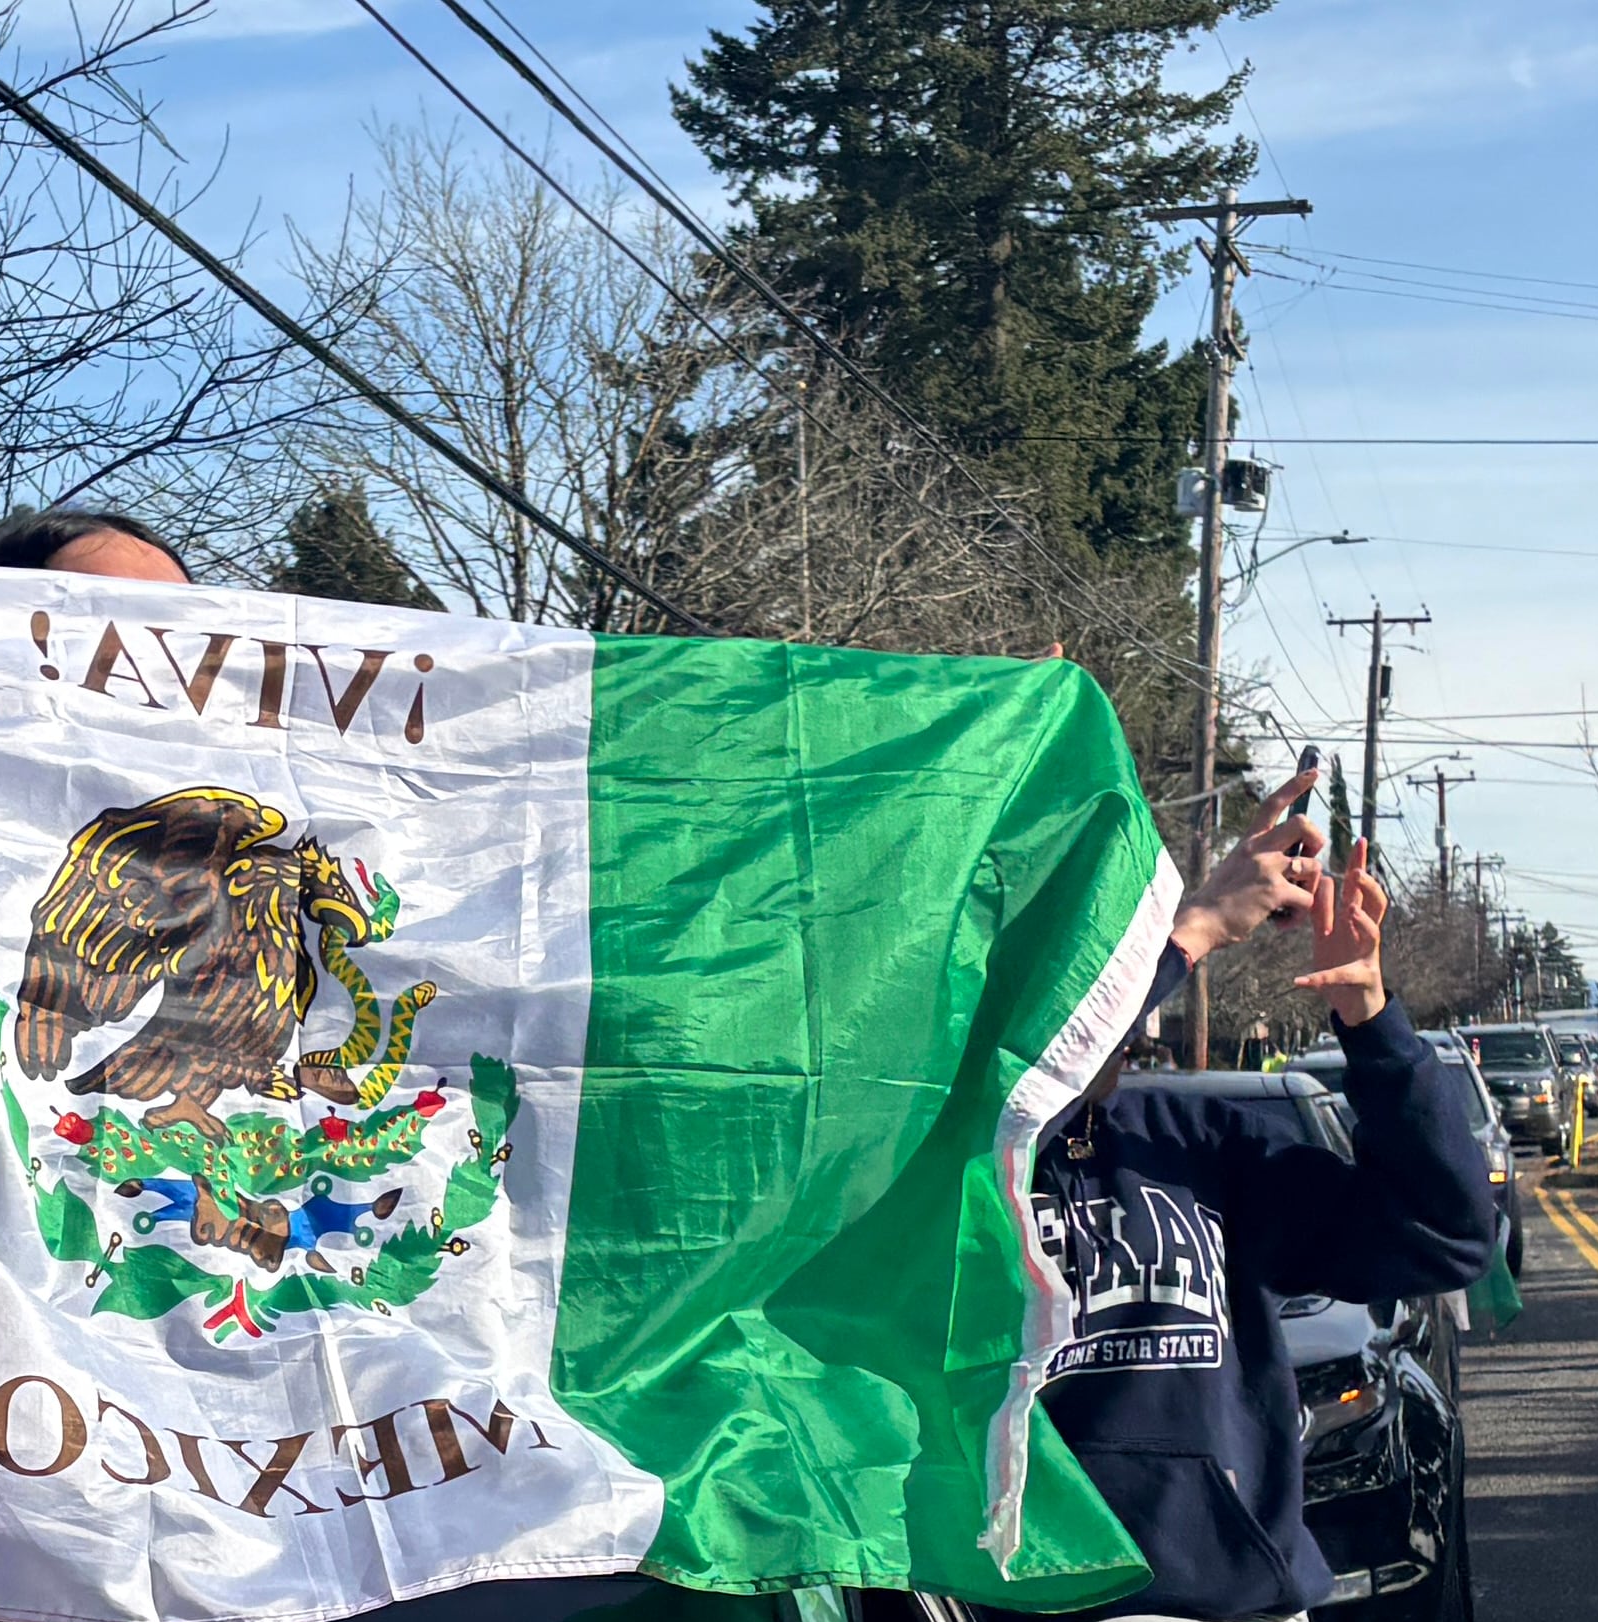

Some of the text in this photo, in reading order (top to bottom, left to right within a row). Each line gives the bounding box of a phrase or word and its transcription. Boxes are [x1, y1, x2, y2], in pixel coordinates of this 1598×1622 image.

[1055, 1335, 1215, 1373] LONE STAR STATE
